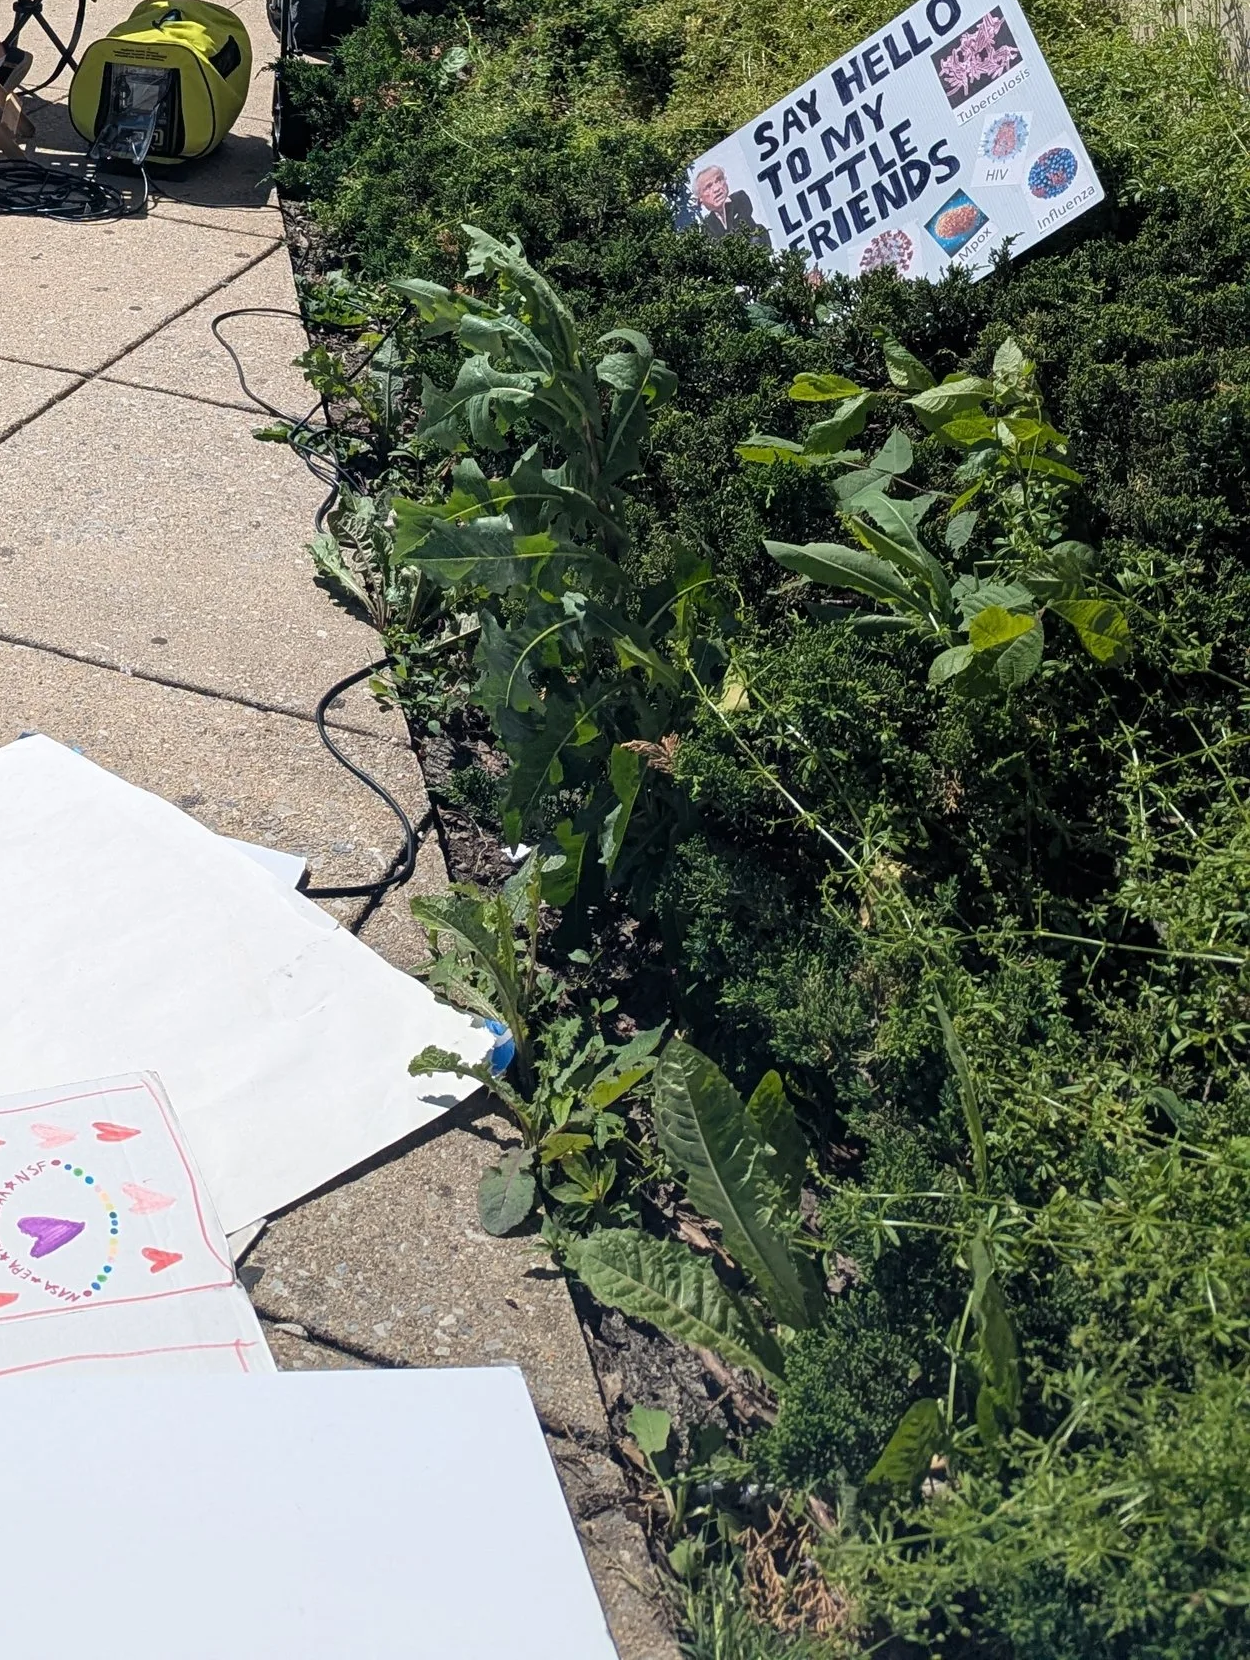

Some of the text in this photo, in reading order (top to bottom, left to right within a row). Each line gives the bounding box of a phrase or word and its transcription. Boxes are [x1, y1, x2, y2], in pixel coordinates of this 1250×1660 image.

[956, 68, 1031, 125] Tuberculosis
[753, 89, 821, 161] SAY
[757, 93, 886, 200] TO MY
[777, 118, 918, 236] LITTLE
[985, 167, 1009, 183] HIV
[1036, 184, 1096, 231] Influenza
[958, 226, 994, 263] Mpox
[14, 1159, 47, 1184] NSF
[8, 1259, 33, 1280] EPA
[44, 1280, 81, 1302] NASA
